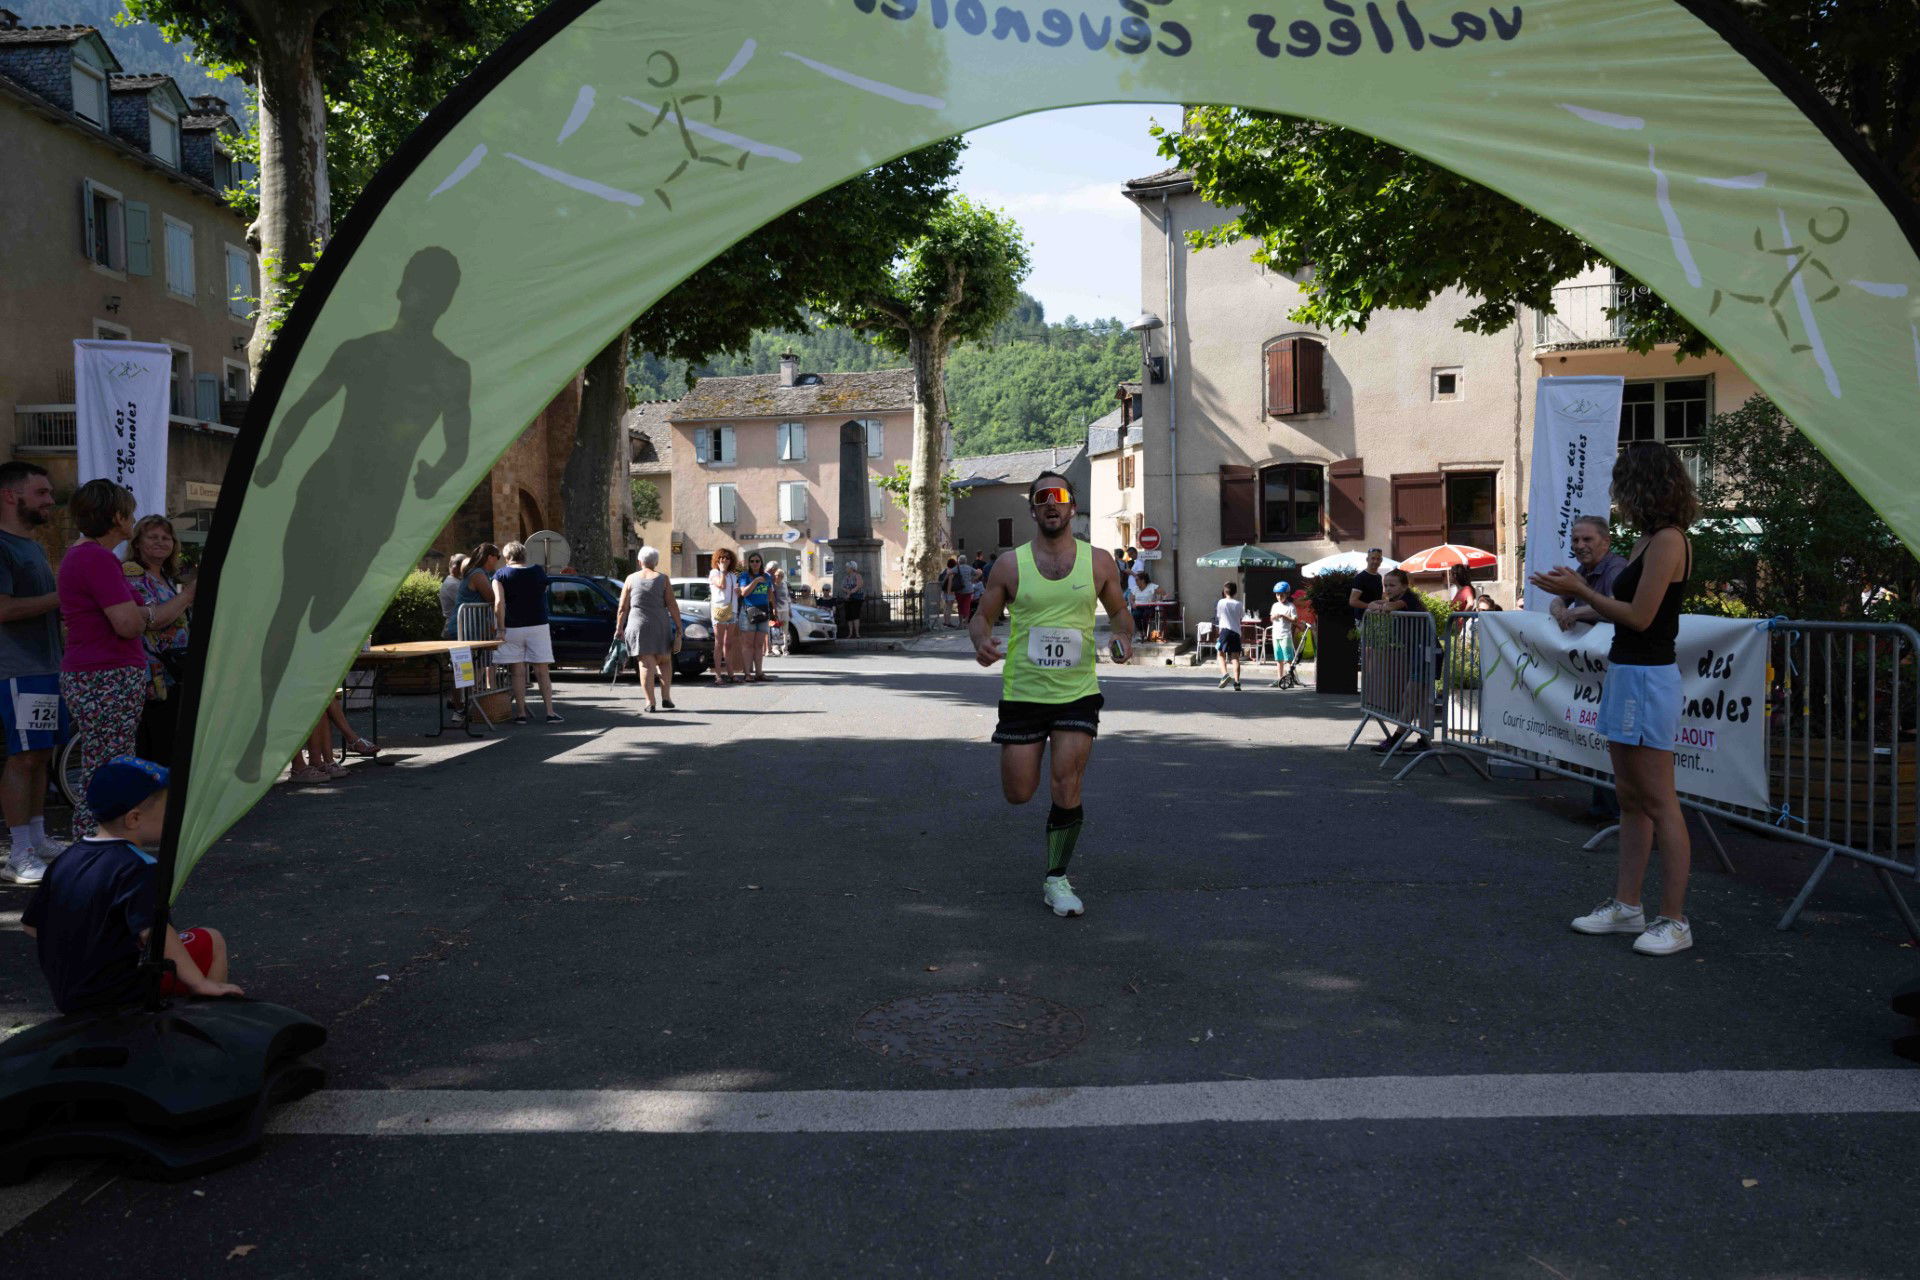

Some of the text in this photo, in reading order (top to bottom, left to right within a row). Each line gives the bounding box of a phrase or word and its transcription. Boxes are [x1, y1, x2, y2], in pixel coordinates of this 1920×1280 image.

[115, 409, 124, 437] des
[126, 401, 137, 474] cévenoles
[1567, 441, 1576, 467] des
[1575, 434, 1588, 498] cévenoles
[1037, 659, 1072, 667] TUFF'S
[1044, 644, 1064, 658] 10
[1568, 649, 1734, 679] Cha des
[1503, 710, 1525, 728] Courir
[1573, 729, 1587, 747] les
[1579, 709, 1598, 726] BAR
[1681, 727, 1715, 747] AOUT
